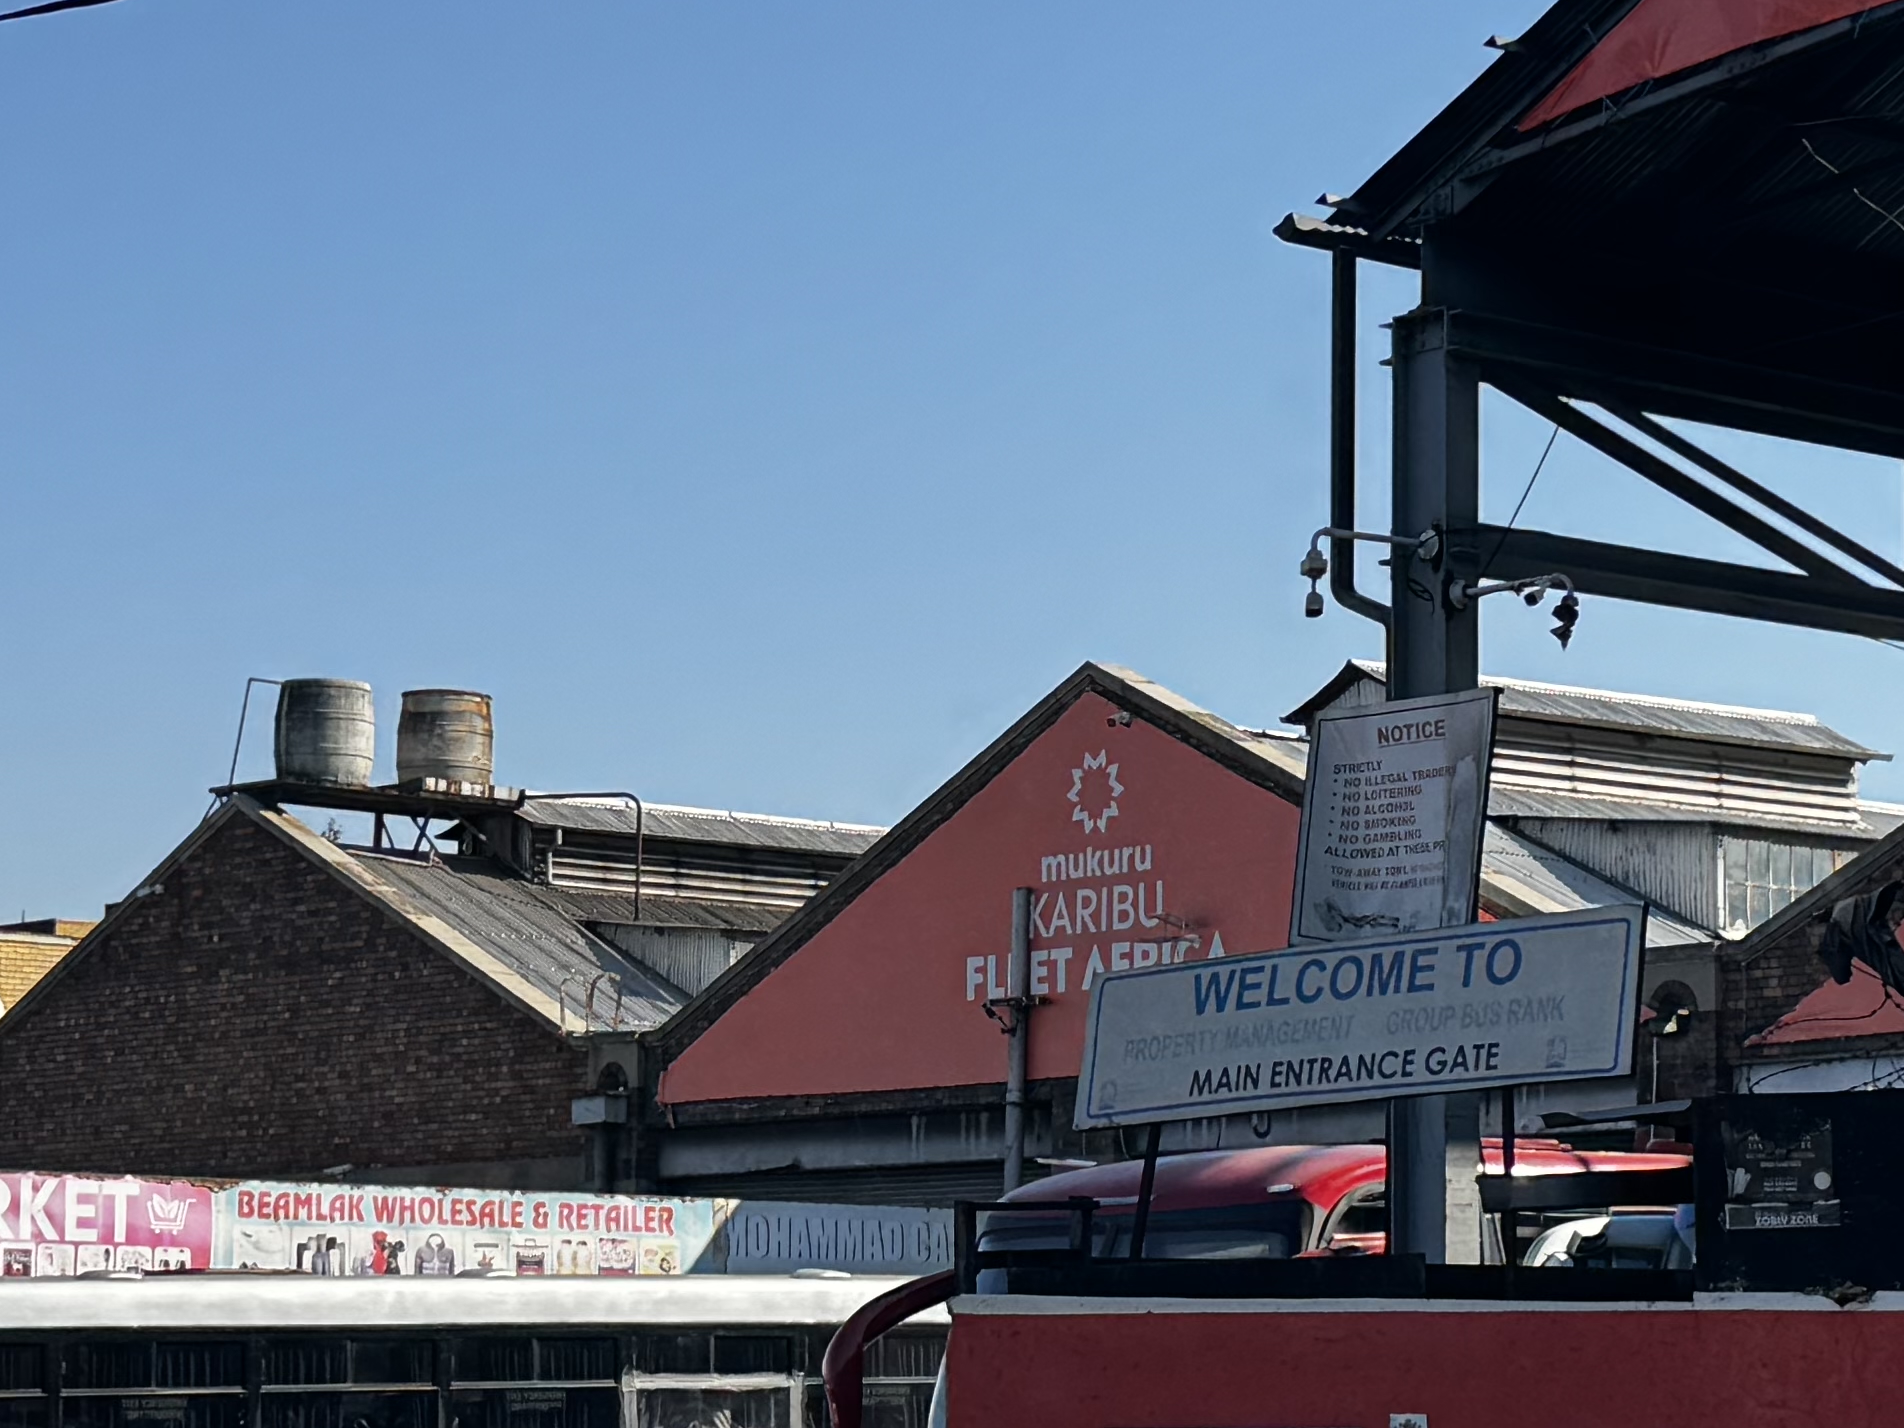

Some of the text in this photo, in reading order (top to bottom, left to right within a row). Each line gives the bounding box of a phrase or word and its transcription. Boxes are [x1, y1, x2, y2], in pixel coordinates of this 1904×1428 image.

[1377, 719, 1446, 746] NOTICE
[1333, 760, 1383, 775] STRICTLY
[1342, 784, 1422, 803] NO LOITERING
[1344, 777, 1361, 788] NO
[1341, 805, 1360, 817] NO
[1339, 819, 1360, 832] NO
[1338, 832, 1359, 845] NO
[1041, 844, 1152, 883] mukuru
[1324, 845, 1384, 860] ALLOWED
[1029, 880, 1163, 939] KARIBU
[1193, 938, 1522, 1016] WELCOME TO
[1122, 1029, 1219, 1064] PROPERTY
[1225, 1013, 1356, 1050] MANAGEMENT
[1386, 1005, 1458, 1036] GROUP
[1506, 994, 1565, 1025] RANK
[1189, 1063, 1262, 1098] MAIN
[1269, 1048, 1416, 1089] ENTRANCE
[1425, 1042, 1500, 1076] GATE
[237, 1189, 676, 1237] BEAMLAK WHOLESALE & RETAILER
